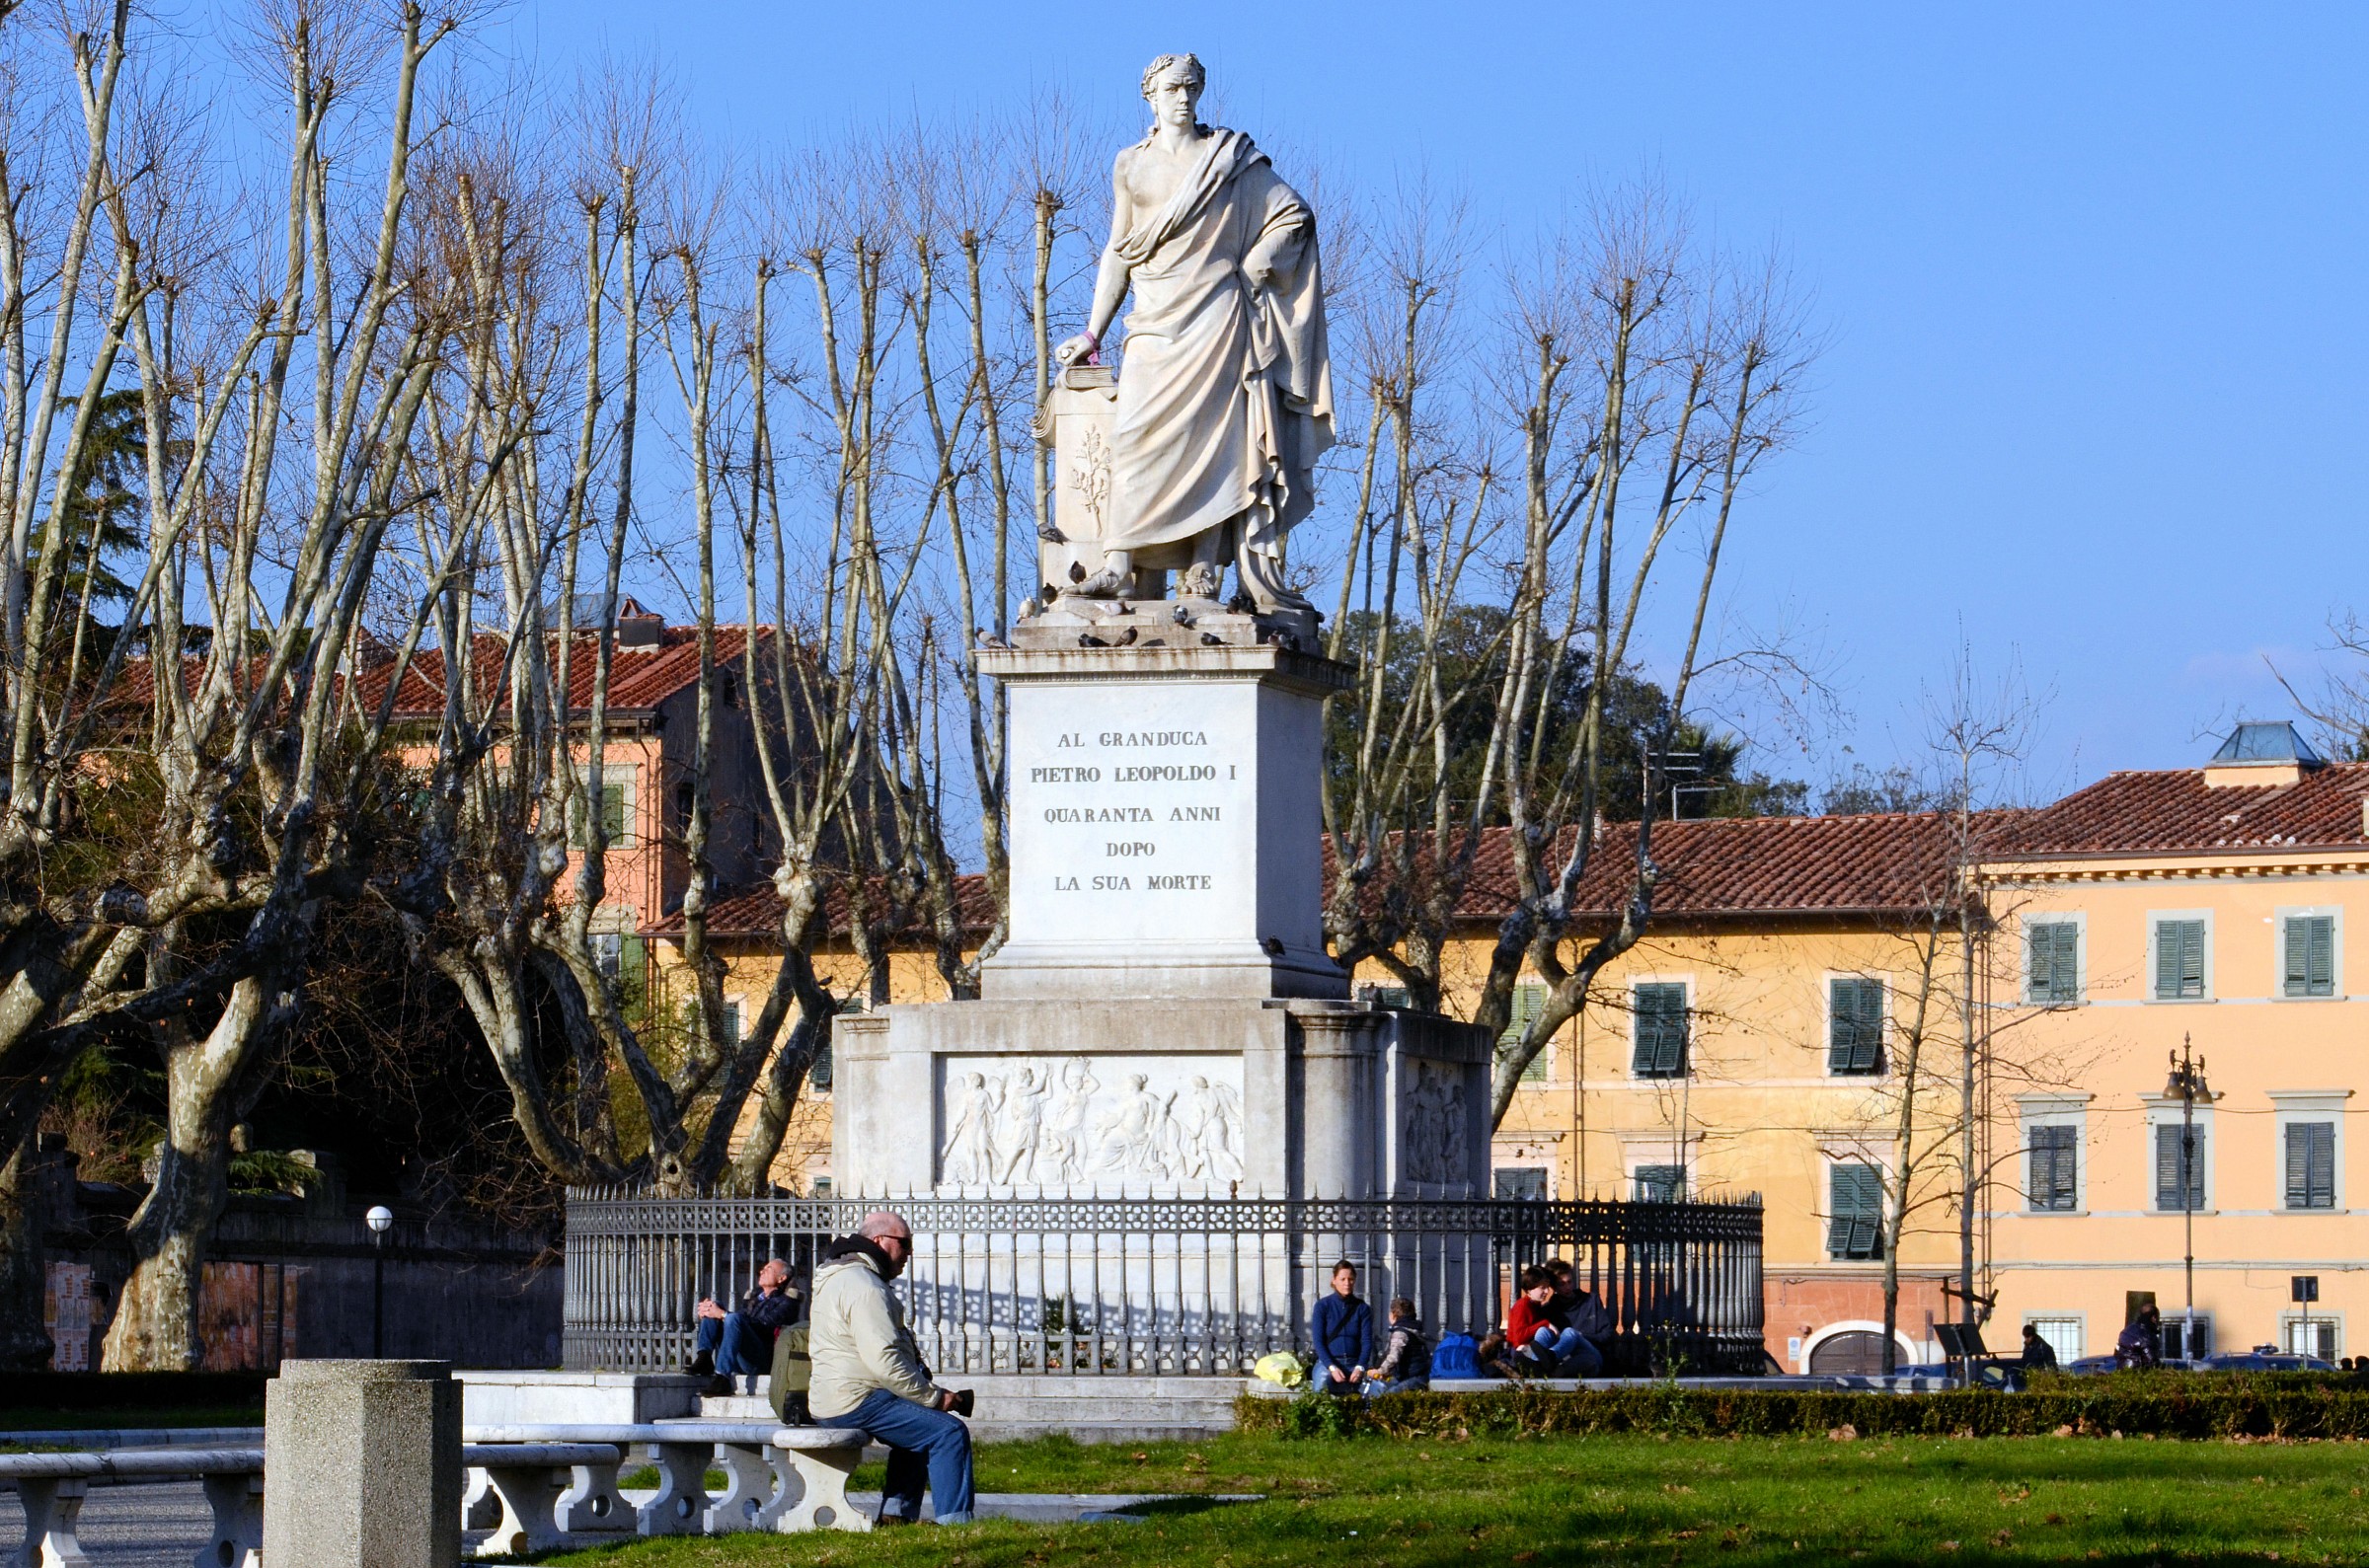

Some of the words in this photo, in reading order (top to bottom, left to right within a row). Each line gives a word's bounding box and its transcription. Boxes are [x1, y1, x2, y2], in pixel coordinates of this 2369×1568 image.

[1058, 733, 1086, 748] AL
[1100, 731, 1208, 747] GRANDUCA
[1031, 768, 1102, 783] PIETRO
[1114, 766, 1216, 782] LEOPOLDO
[1229, 765, 1237, 781] I
[1044, 808, 1155, 825] QUARANTA
[1170, 807, 1221, 822] ANNI
[1107, 843, 1156, 858] DOPO
[1055, 877, 1082, 891] LA
[1093, 876, 1132, 890] SUA
[1148, 875, 1212, 890] MORTE
